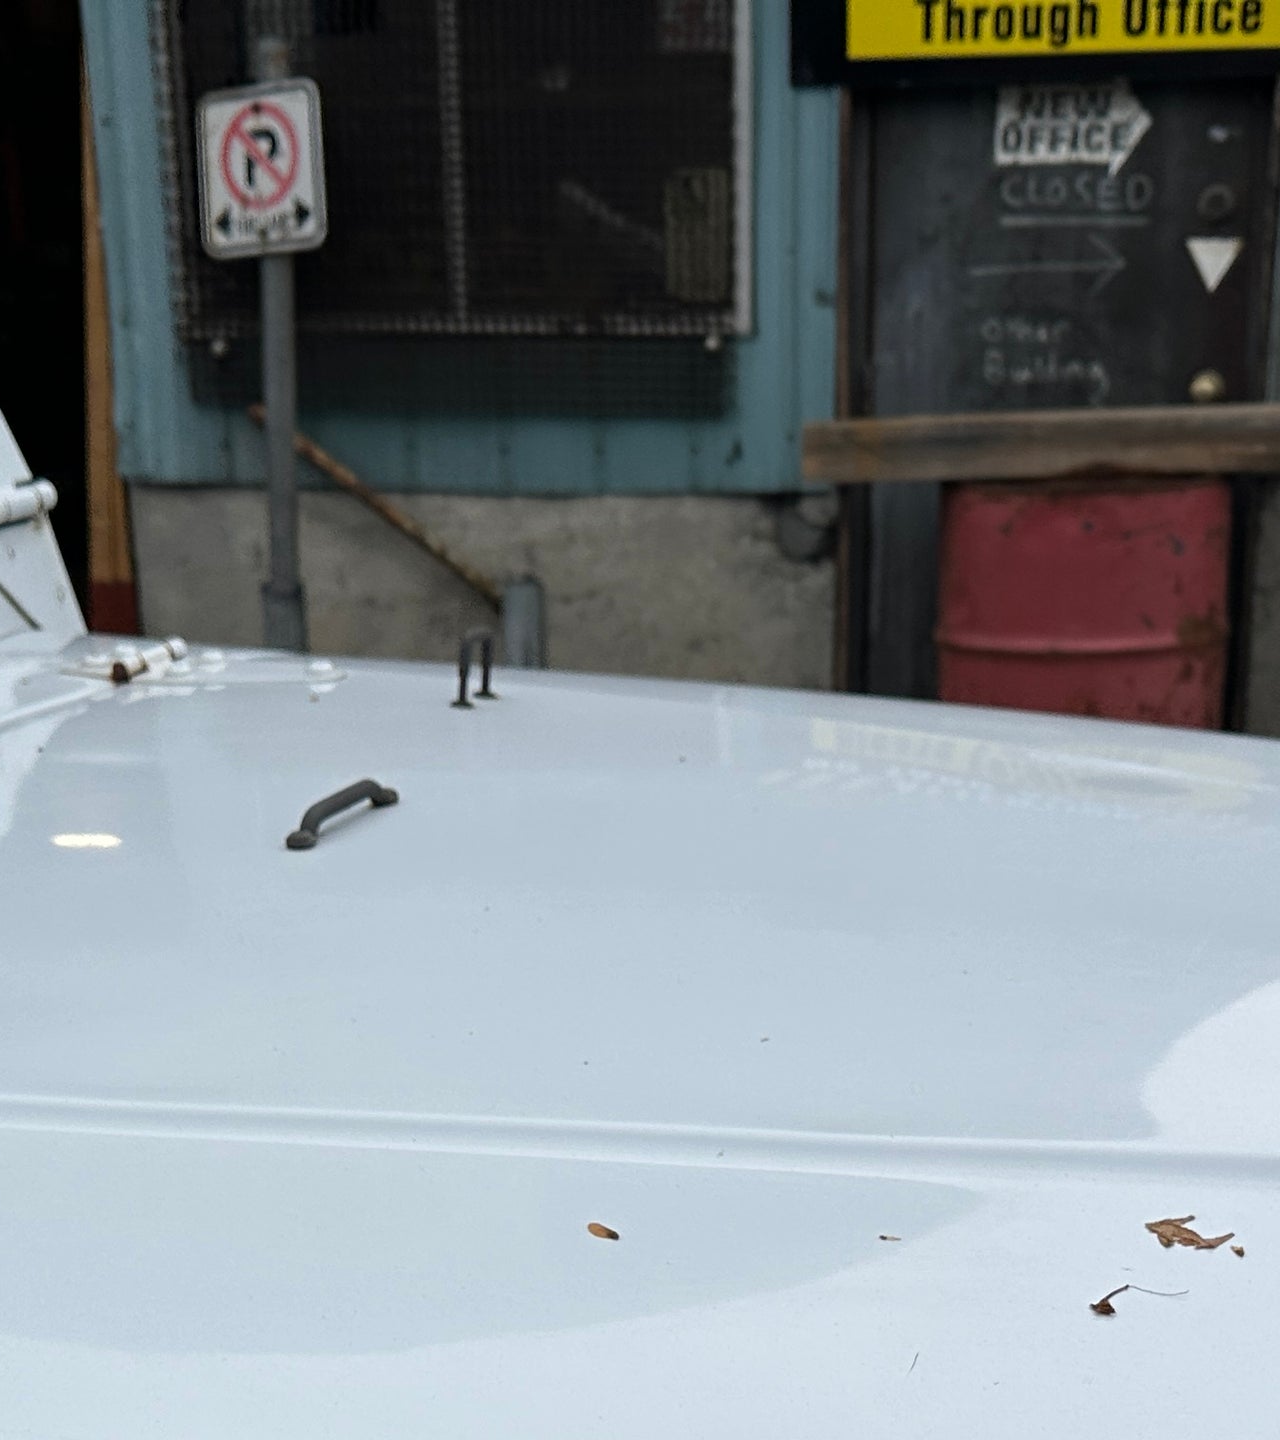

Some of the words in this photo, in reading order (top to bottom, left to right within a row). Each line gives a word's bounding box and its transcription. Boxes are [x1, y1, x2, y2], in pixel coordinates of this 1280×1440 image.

[921, 0, 1097, 47] Through
[1124, 0, 1262, 37] Office
[1019, 88, 1112, 120] NEW
[1001, 121, 1131, 153] OFFICE
[1000, 172, 1153, 211] CLOSED
